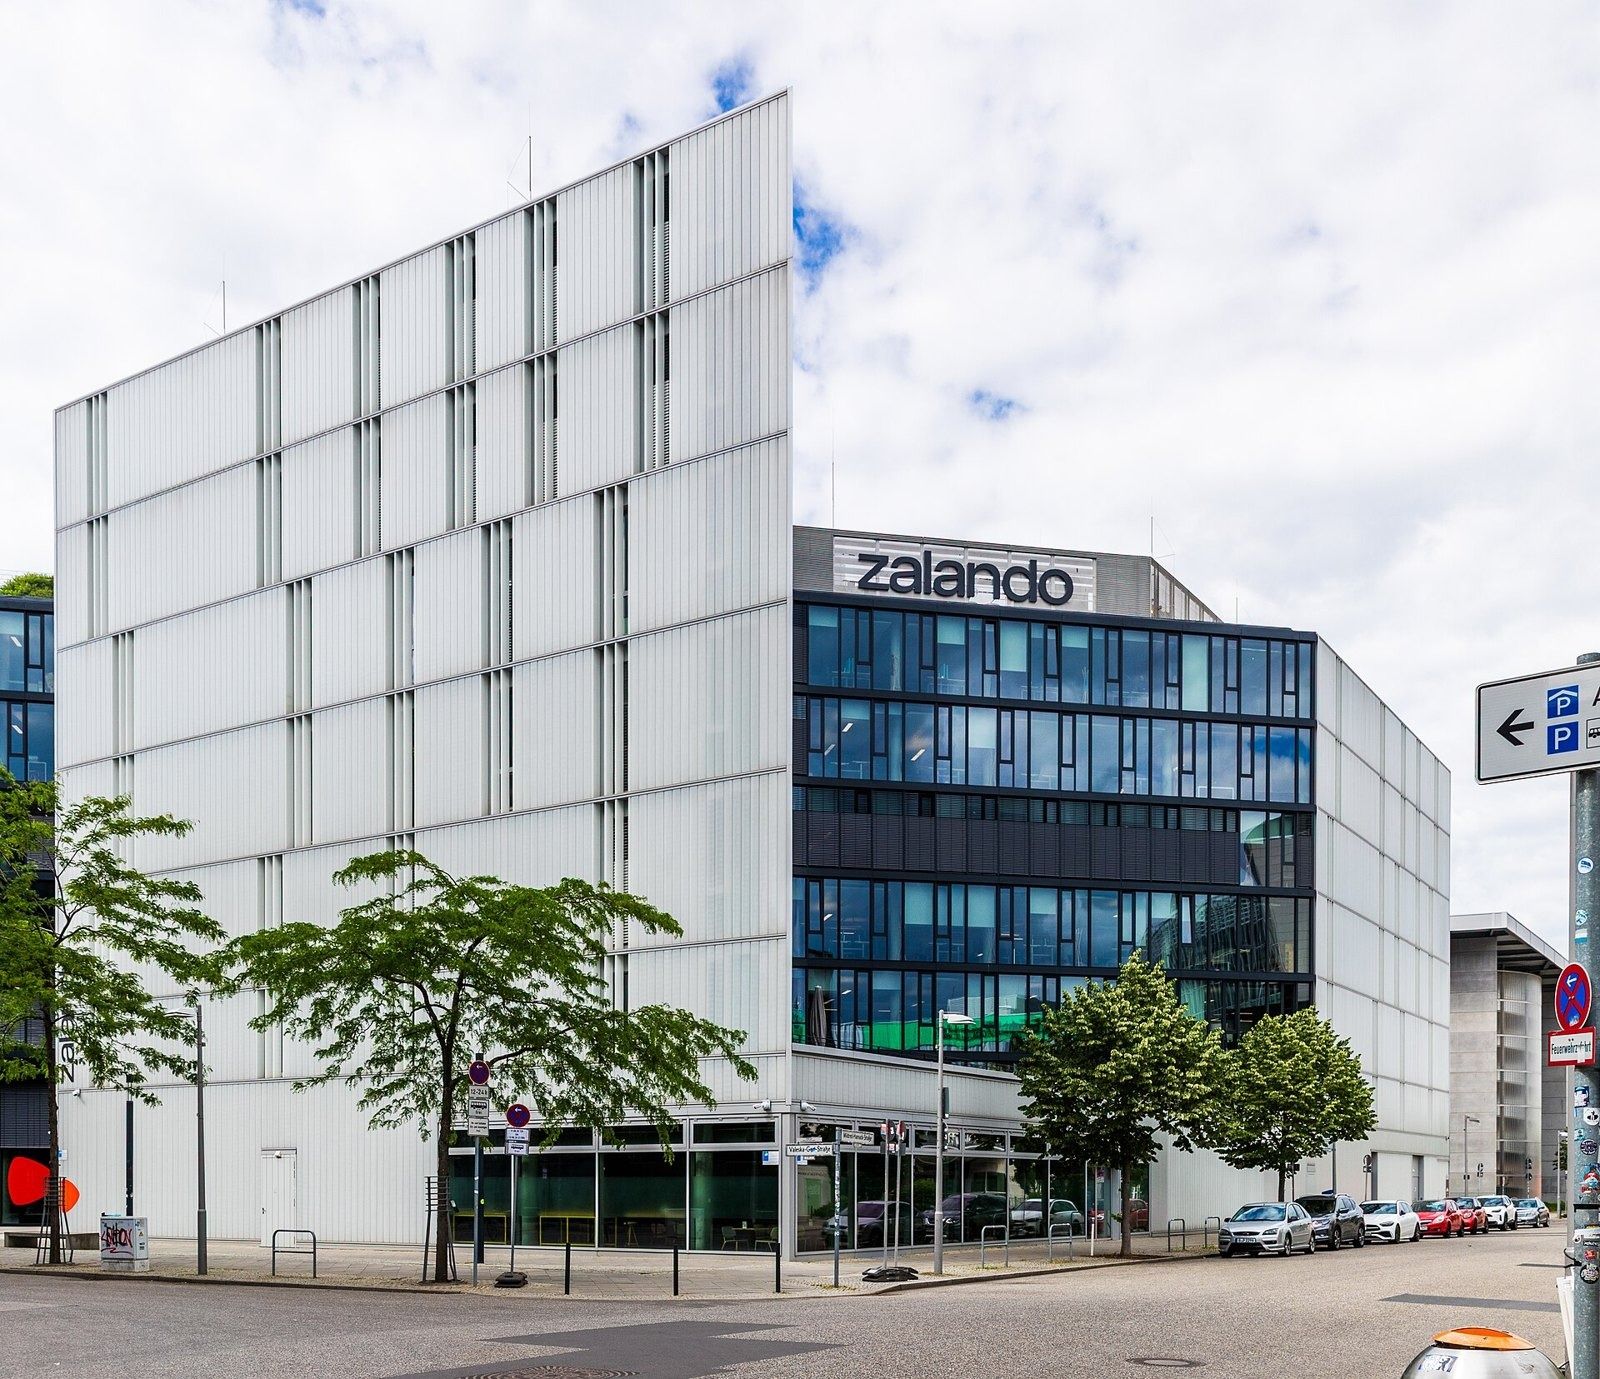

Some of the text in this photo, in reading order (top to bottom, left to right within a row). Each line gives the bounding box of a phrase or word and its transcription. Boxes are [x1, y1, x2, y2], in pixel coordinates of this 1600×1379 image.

[858, 550, 1074, 606] zalando
[1556, 696, 1571, 716] P
[1554, 726, 1572, 750] P
[1551, 1040, 1592, 1055] Feuerwehrzfhrt
